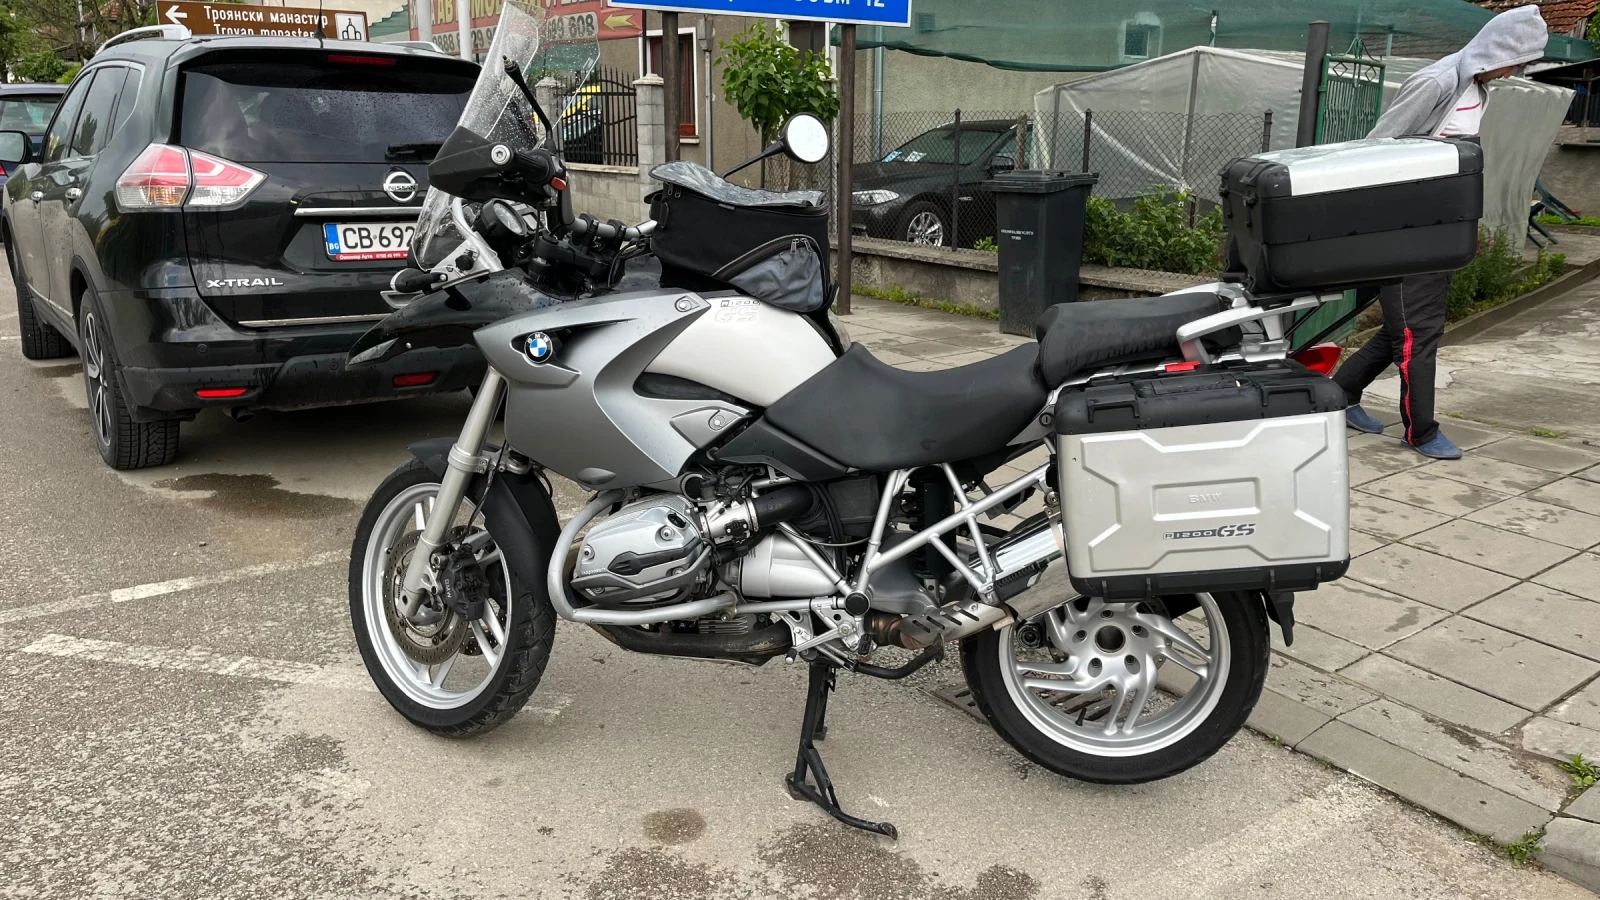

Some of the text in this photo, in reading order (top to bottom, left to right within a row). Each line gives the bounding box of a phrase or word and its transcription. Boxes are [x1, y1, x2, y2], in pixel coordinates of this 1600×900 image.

[203, 5, 328, 28] Троянски манастир
[260, 27, 316, 37] monaster
[329, 242, 340, 250] BG
[207, 277, 284, 288] X-TRAIL
[1189, 493, 1222, 503] BMW
